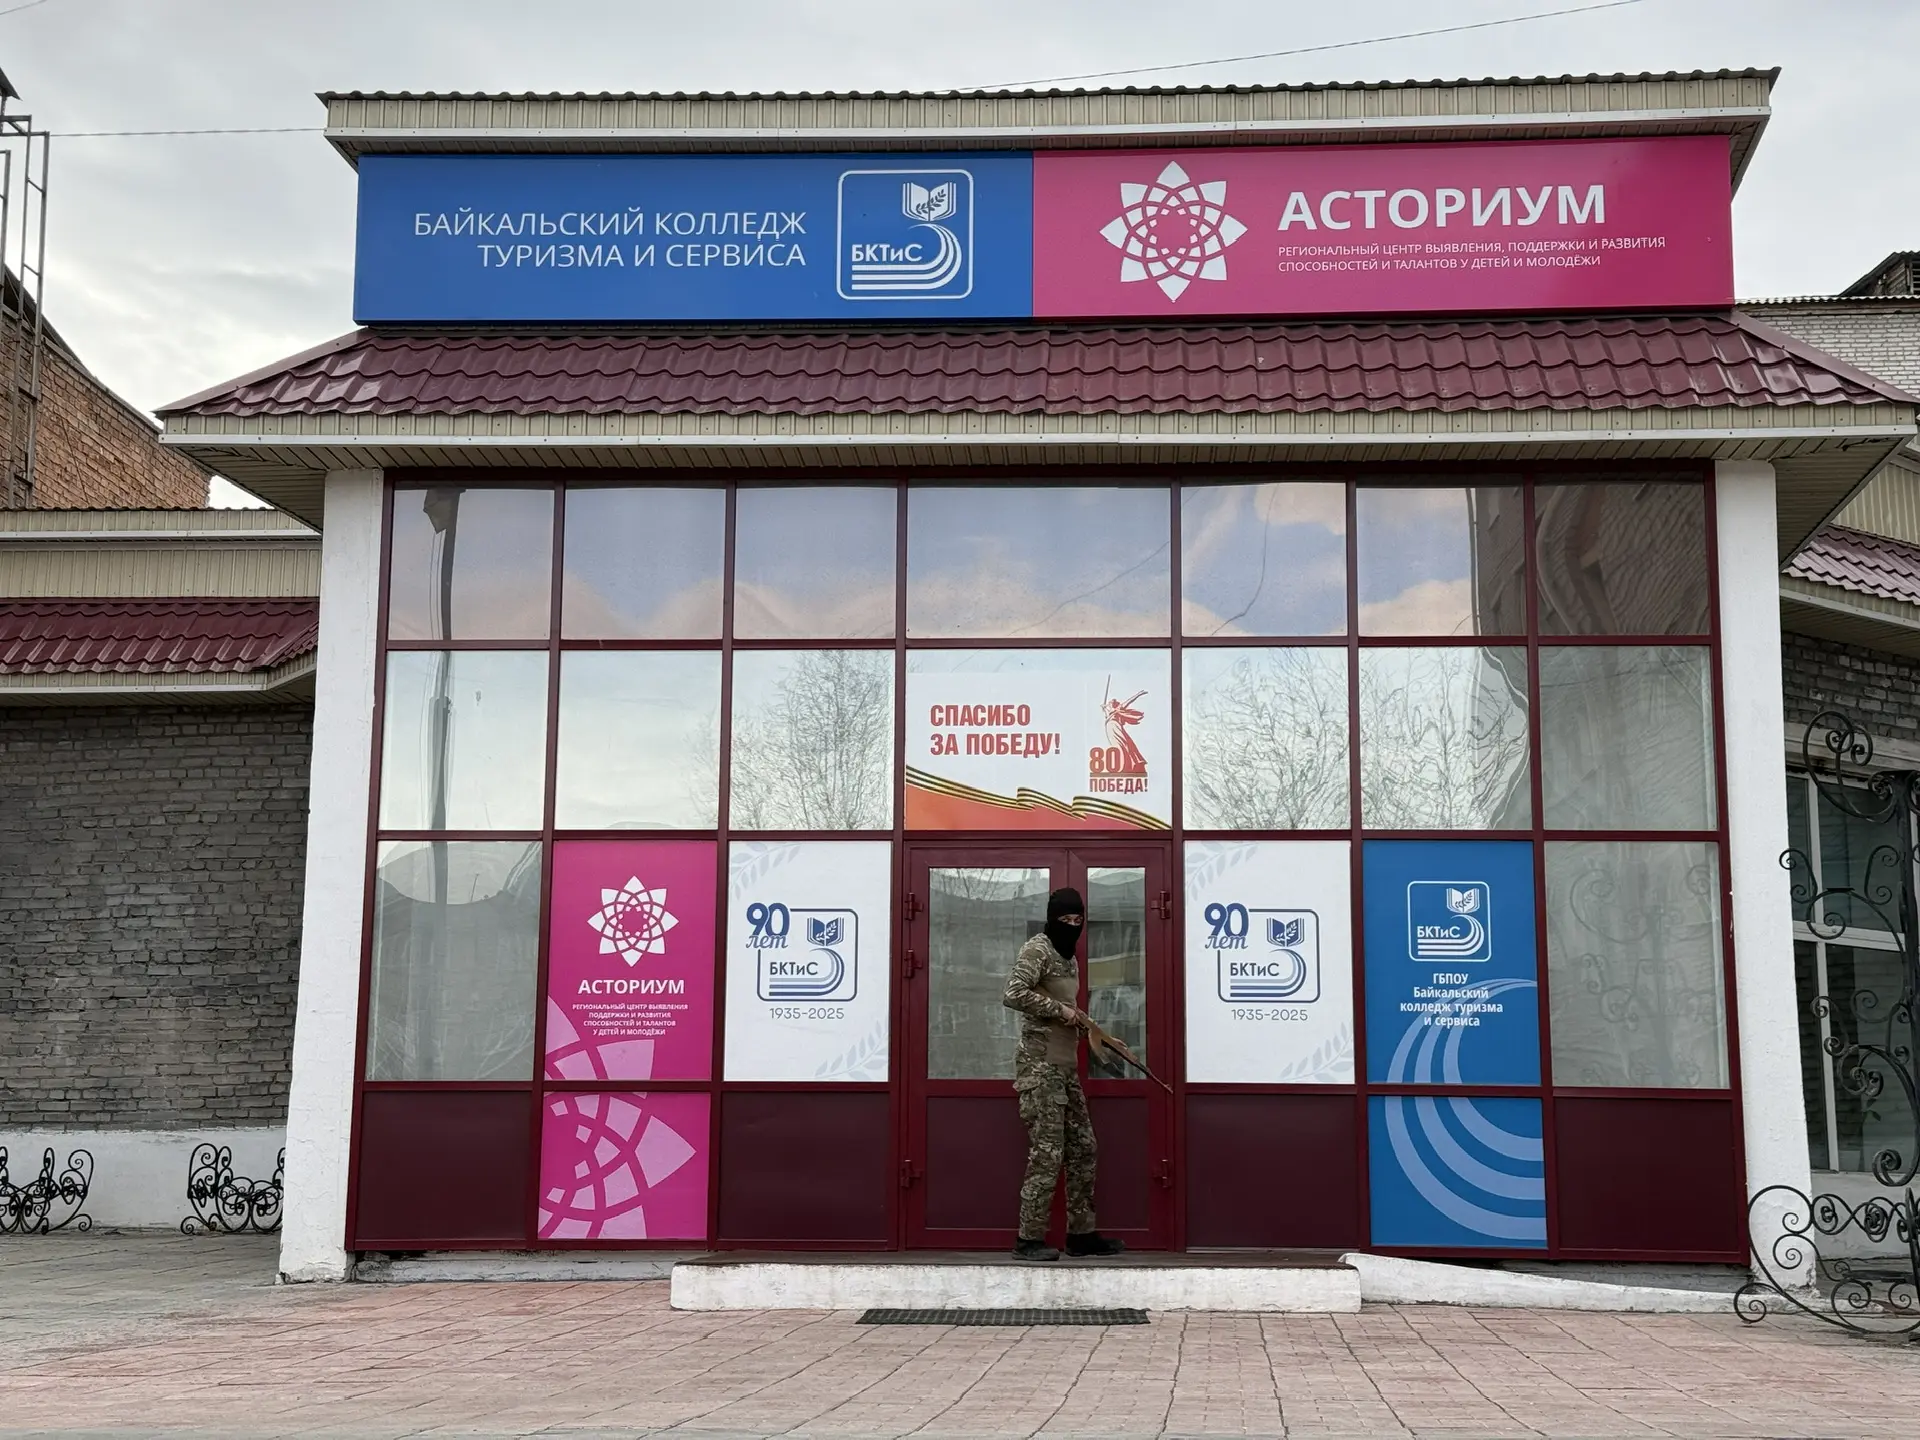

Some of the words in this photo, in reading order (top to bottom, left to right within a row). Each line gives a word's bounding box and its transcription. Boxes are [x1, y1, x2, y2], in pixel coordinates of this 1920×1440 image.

[1278, 185, 1605, 231] АСТОРИУМ
[415, 207, 644, 236] БАЙКАЛЬСКИЙ
[655, 212, 807, 241] КОЛЛЕДЖ
[851, 243, 923, 262] БКТиС
[1279, 243, 1379, 257] РЕГИОНАЛЬНЫЙ
[1383, 244, 1422, 256] ЦЕНТР
[1425, 242, 1504, 254] ВЫЯВЛЕНИЯ,
[1509, 240, 1585, 253] ПОДДЕРЖКИ
[1589, 240, 1598, 250] И
[1602, 237, 1666, 249] РАЗВИТИЯ
[477, 244, 631, 267] ТУРИЗМА
[635, 244, 655, 266] И
[666, 244, 806, 266] СЕРВИСА
[1279, 259, 1378, 272] СПОСОБНОСТЕЙ
[1382, 260, 1390, 270] И
[1394, 259, 1457, 270] ТАЛАНТОВ
[1460, 258, 1469, 269] У
[1472, 256, 1510, 269] ДЕТЕЙ
[1514, 257, 1523, 267] И
[1526, 255, 1600, 268] МОЛОДЁЖИ
[930, 704, 1031, 726] СПАСИБО
[930, 734, 959, 755] ЗА
[967, 733, 1061, 758] ПОБЕДУ!
[1089, 747, 1121, 773] 80
[1089, 778, 1148, 794] ПОБЕДА!
[746, 902, 790, 937] 90
[1204, 902, 1249, 937] 90
[1417, 926, 1460, 938] БКТиС
[746, 933, 789, 949] лет
[1204, 934, 1248, 950] лет
[769, 961, 818, 976] БКТиС
[1230, 963, 1280, 977] БКТиС
[578, 980, 684, 994] АСТОРИУМ
[1433, 974, 1469, 985] ГБПОУ
[1414, 987, 1489, 998] Байкальский
[769, 1008, 844, 1019] 1935-2025
[1231, 1009, 1308, 1021] 1935-2025
[1400, 1003, 1451, 1015] колледж
[1455, 1003, 1503, 1015] туризма
[1424, 1017, 1432, 1026] и
[1435, 1017, 1480, 1029] сервиса
